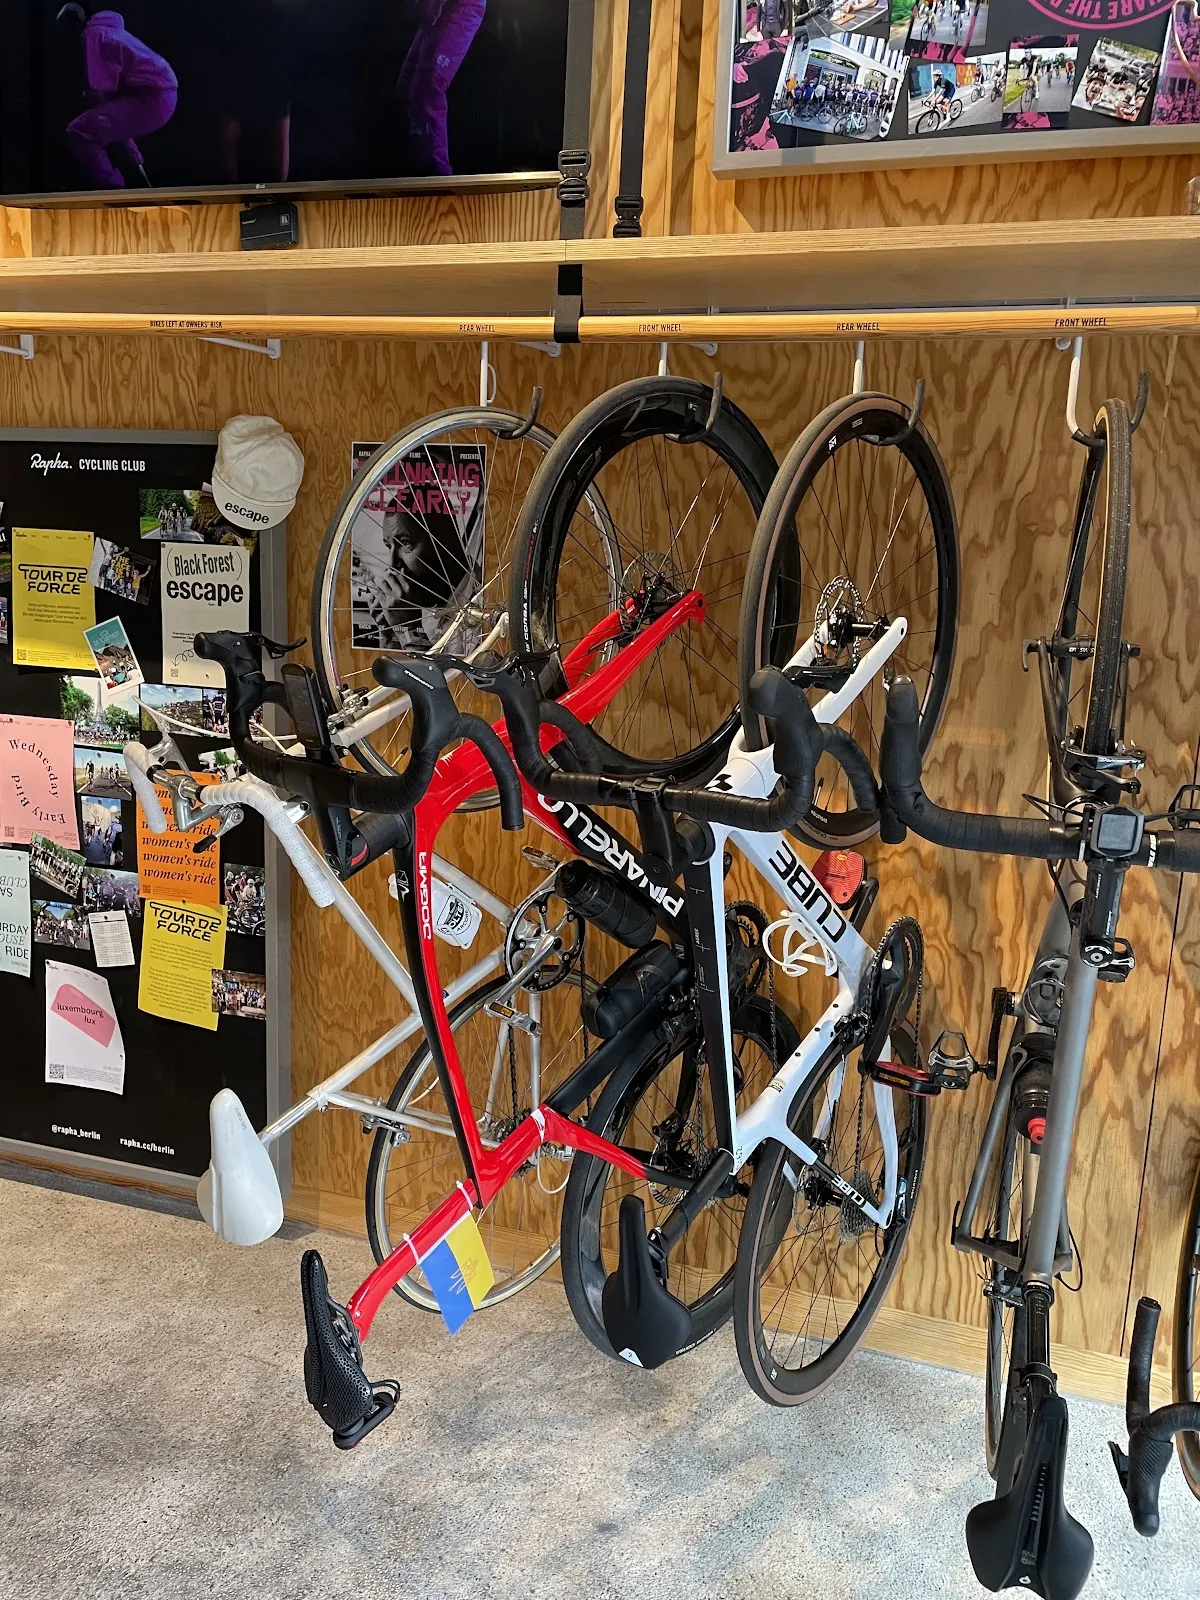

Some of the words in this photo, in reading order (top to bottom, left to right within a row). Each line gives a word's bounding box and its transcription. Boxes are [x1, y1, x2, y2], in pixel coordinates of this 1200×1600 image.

[1065, 0, 1101, 19] THE
[459, 324, 474, 332] REAR
[476, 324, 496, 332] WHEEL
[639, 324, 659, 332] FRONT
[661, 323, 681, 331] WHEEL
[836, 323, 854, 331] REAR
[856, 322, 880, 331] WHEEL
[1055, 318, 1079, 327] FRONT
[1082, 317, 1107, 326] WHEEL
[79, 459, 118, 471] CYCLING
[121, 460, 146, 472] CLUB
[364, 487, 471, 514] CLEARLY
[224, 502, 270, 524] escape
[174, 553, 202, 576] Black
[202, 552, 235, 574] Forest
[20, 566, 62, 582] TOUR
[66, 567, 88, 583] DE
[27, 581, 81, 595] FORCE
[166, 580, 244, 606] escape
[9, 738, 59, 799] Wednesday
[11, 774, 30, 807] Bird
[32, 806, 66, 825] Early
[142, 836, 192, 850] women's
[143, 851, 192, 865] women's
[193, 856, 216, 869] ride
[538, 793, 685, 918] PINARELLO
[143, 867, 193, 882] women's
[193, 873, 216, 886] ride
[418, 851, 432, 941] DOGMA
[768, 840, 847, 944] CUBE
[151, 904, 196, 926] TOUR
[198, 917, 221, 933] DE
[157, 919, 211, 942] FORCE
[5, 945, 29, 960] RIDE
[57, 1002, 104, 1018] luxembourg
[84, 1015, 97, 1025] lux
[51, 1124, 101, 1140] @rapha_berlin
[119, 1137, 175, 1155] rapha.cc/berlin
[831, 1174, 866, 1208] CUBE
